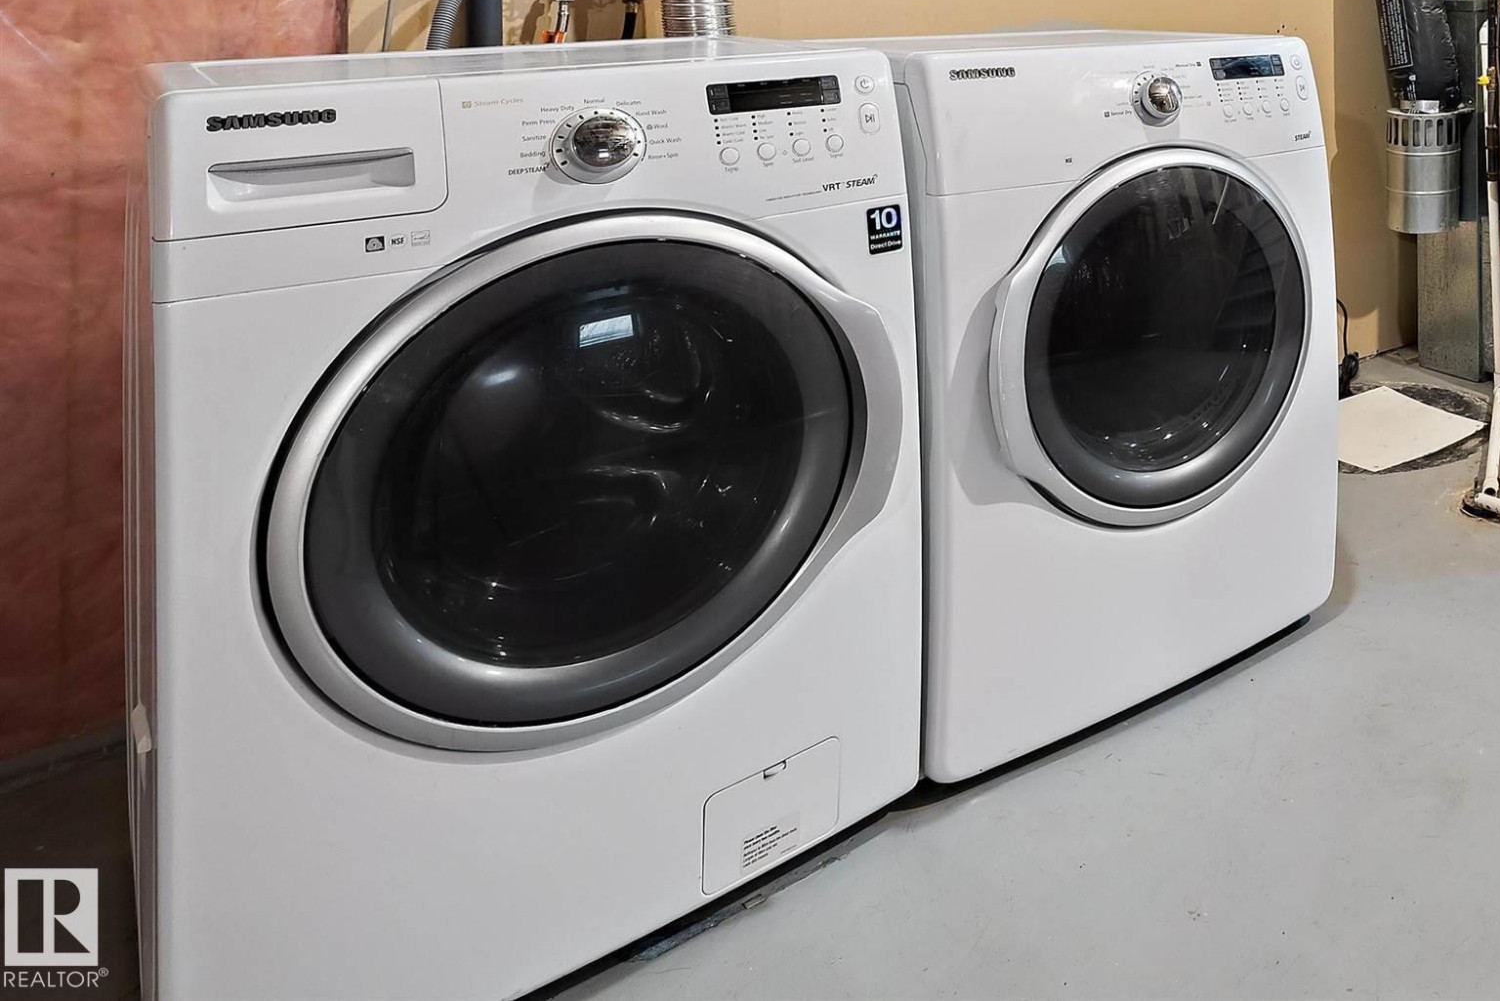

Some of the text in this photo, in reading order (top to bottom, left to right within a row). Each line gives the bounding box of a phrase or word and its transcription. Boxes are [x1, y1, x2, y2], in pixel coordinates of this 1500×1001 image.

[950, 67, 1016, 81] SAMSUNG
[206, 108, 336, 132] SAMSUNG
[522, 134, 547, 142] Sanitize
[846, 176, 875, 188] STEAM
[870, 207, 898, 230] 10
[391, 237, 404, 245] NSF
[870, 242, 887, 250] Direct
